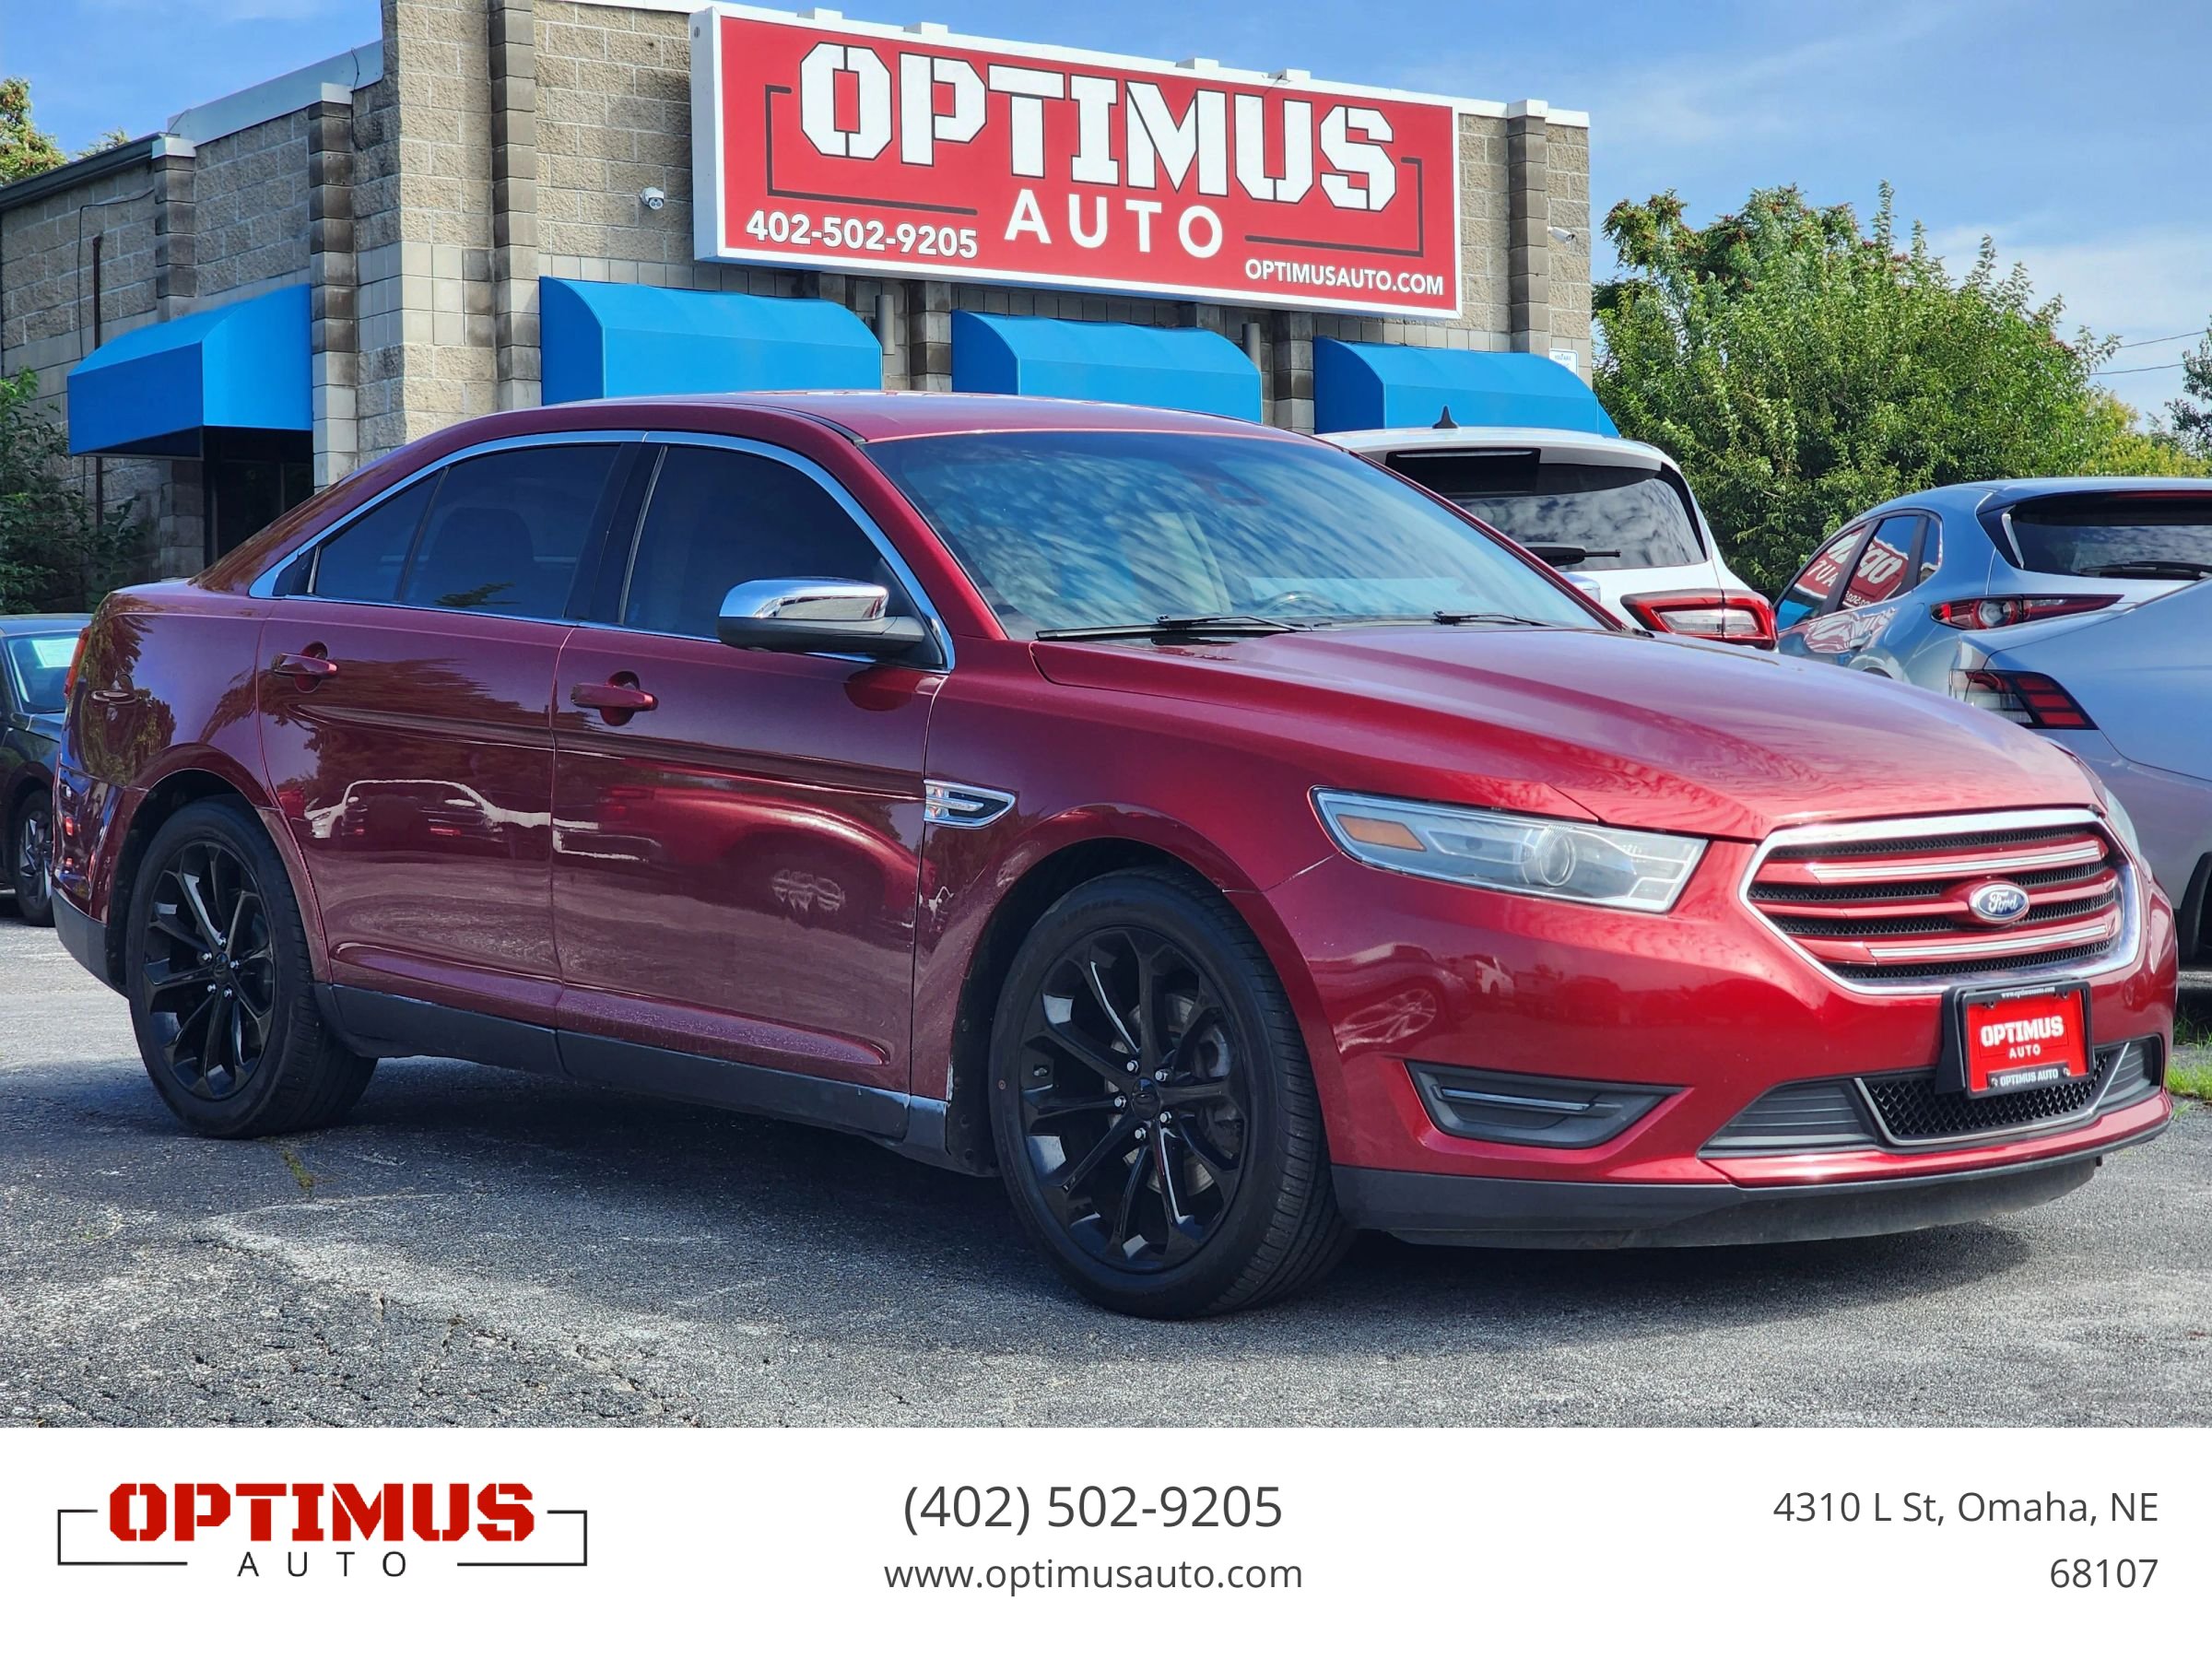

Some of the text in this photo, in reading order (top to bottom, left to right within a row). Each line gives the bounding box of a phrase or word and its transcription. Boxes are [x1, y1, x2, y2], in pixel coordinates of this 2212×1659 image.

[800, 42, 1396, 212] OPTIMUS
[746, 209, 979, 259] 402-502-9205
[1004, 188, 1224, 258] AUTO
[1245, 258, 1444, 296] OPTIMUSAUTO.COM
[1988, 890, 2018, 913] Ford
[1980, 1015, 2065, 1047] OPTIMUS
[2008, 1043, 2041, 1059] AUTO
[1999, 1068, 2059, 1087] OPTIMUS AUTO
